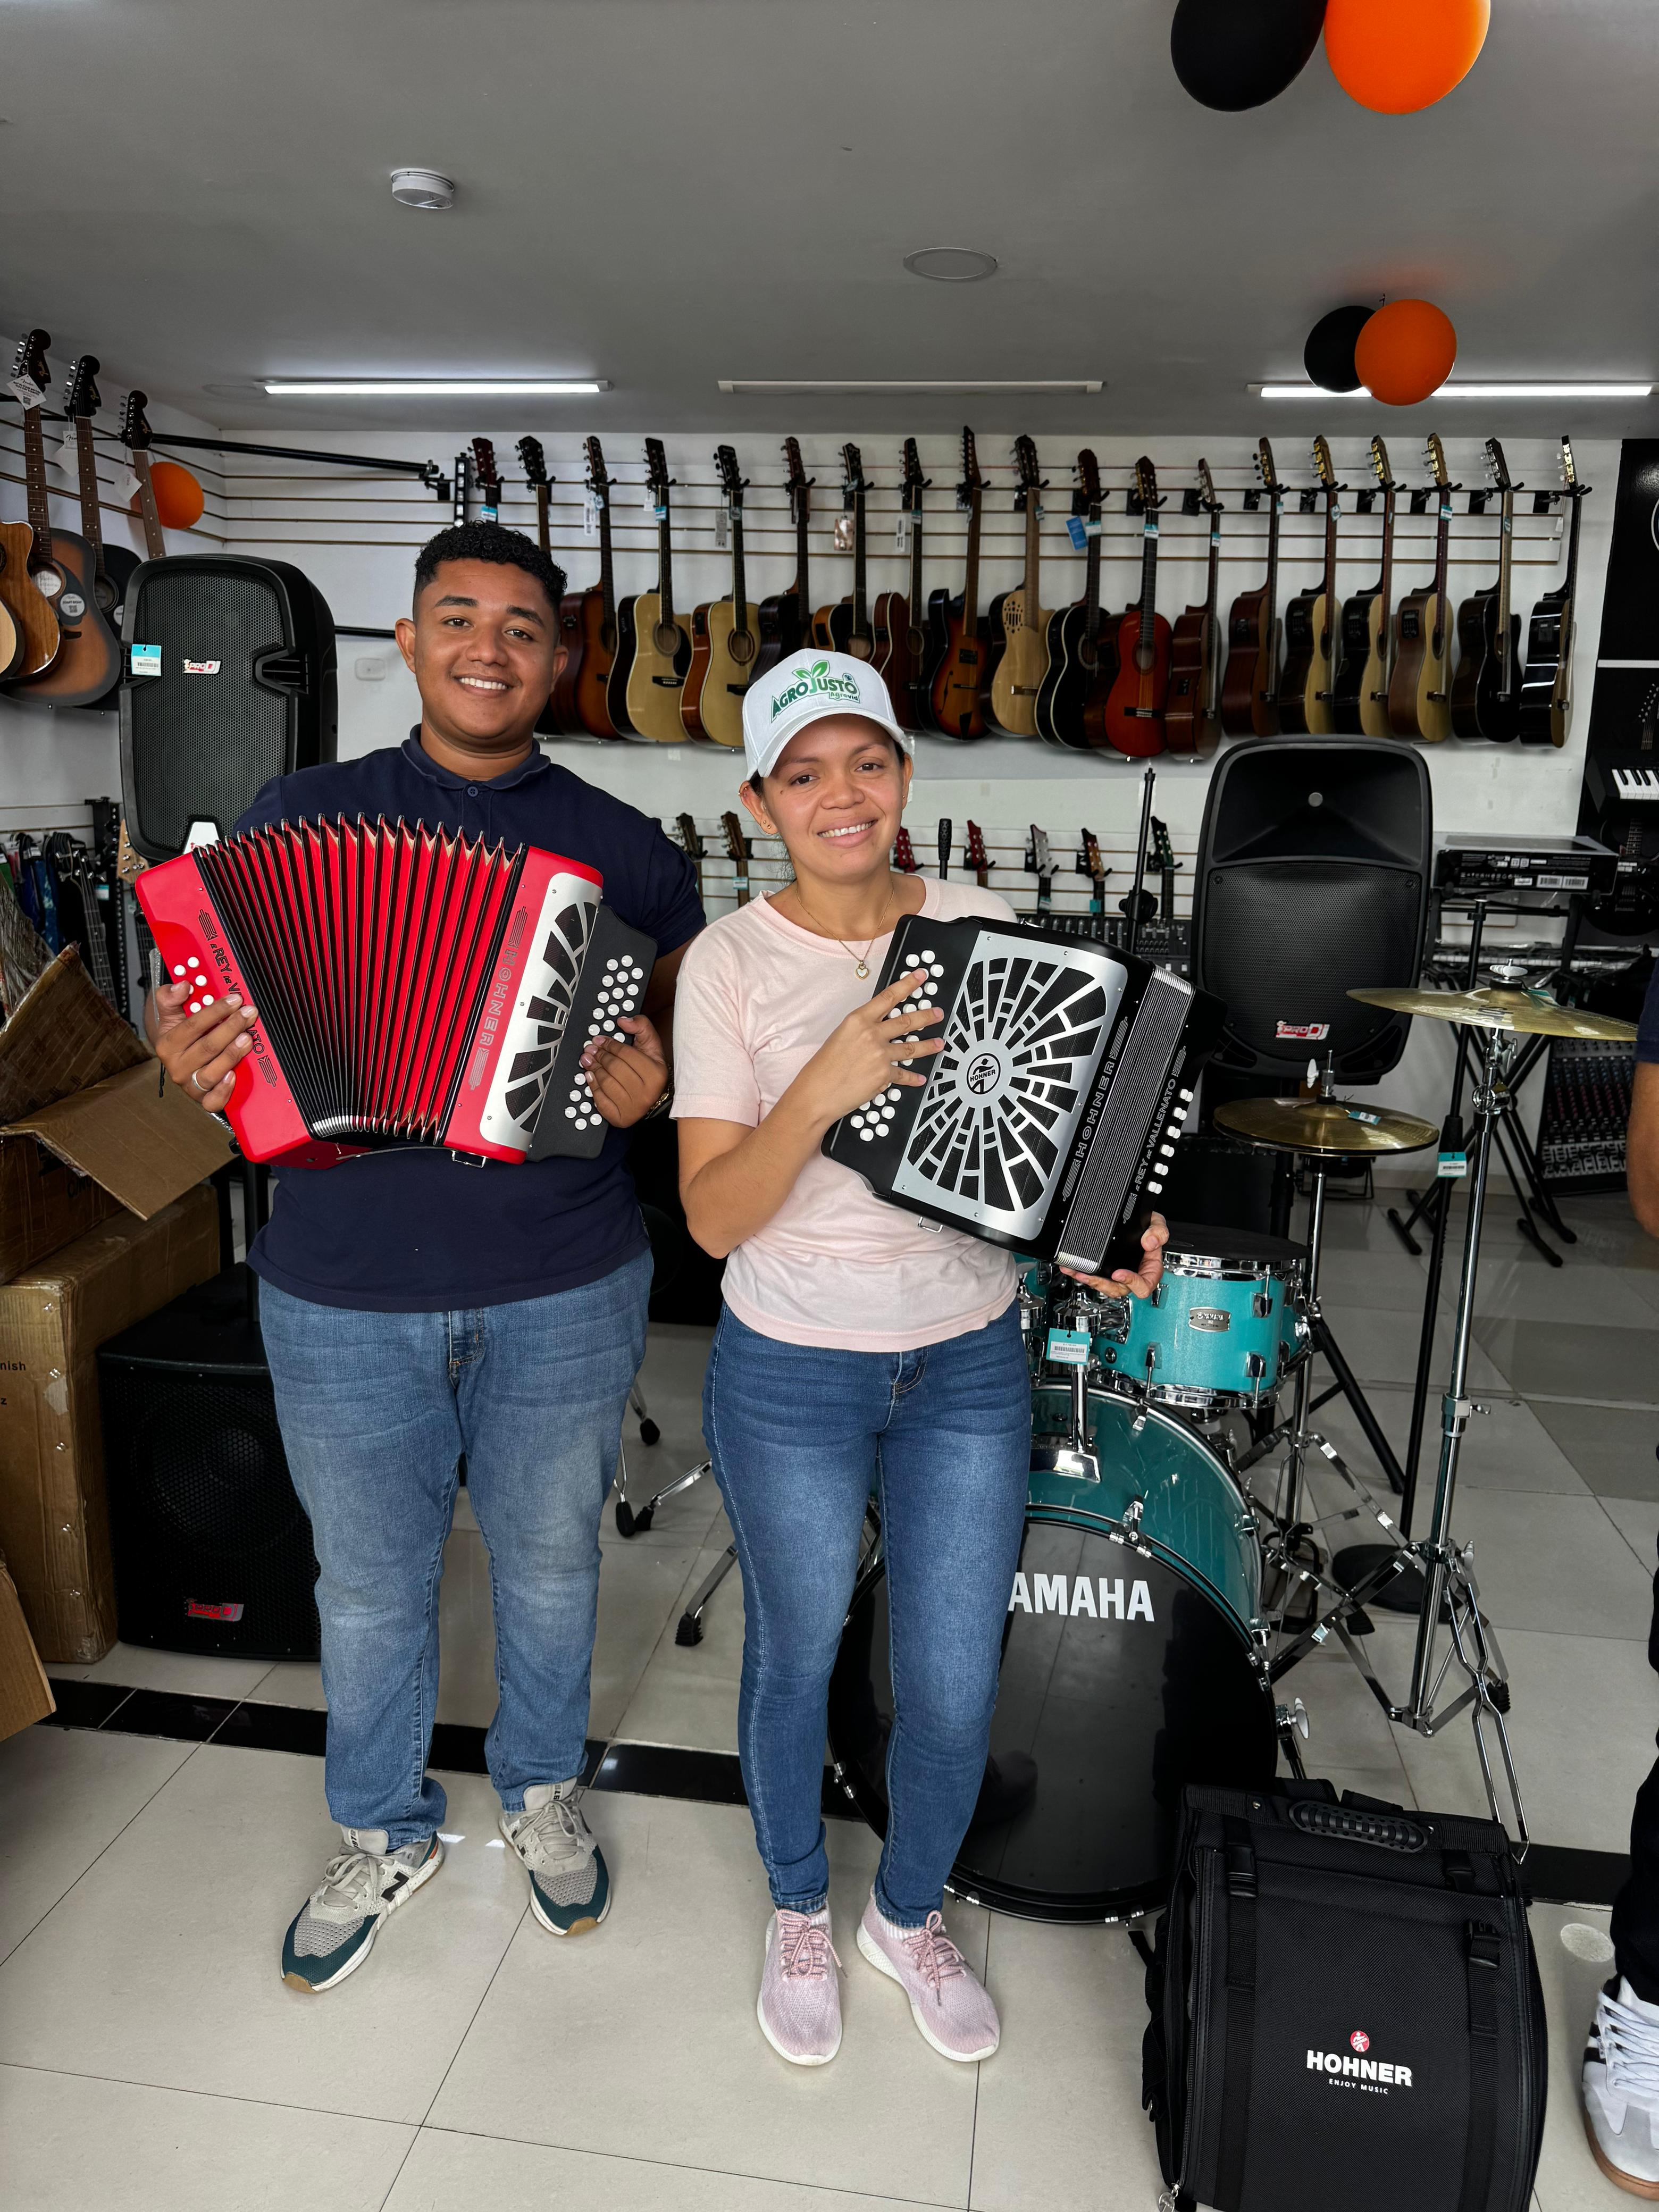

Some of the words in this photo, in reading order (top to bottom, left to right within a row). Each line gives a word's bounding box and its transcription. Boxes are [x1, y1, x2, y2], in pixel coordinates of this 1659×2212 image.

[831, 692, 858, 701] Agrovid
[213, 947, 232, 973] REY
[479, 949, 517, 1046] HOHNER
[970, 1069, 995, 1082] HOHNER
[1075, 1060, 1115, 1158] HOHNER
[1135, 1158, 1149, 1185] REY
[1146, 1078, 1176, 1149] VALLENATO
[1008, 1572, 1155, 1622] AMAHA
[1306, 2050, 1412, 2087] HOHNER
[1329, 2078, 1356, 2088] ENJOY
[1361, 2084, 1388, 2094] MUSIC
